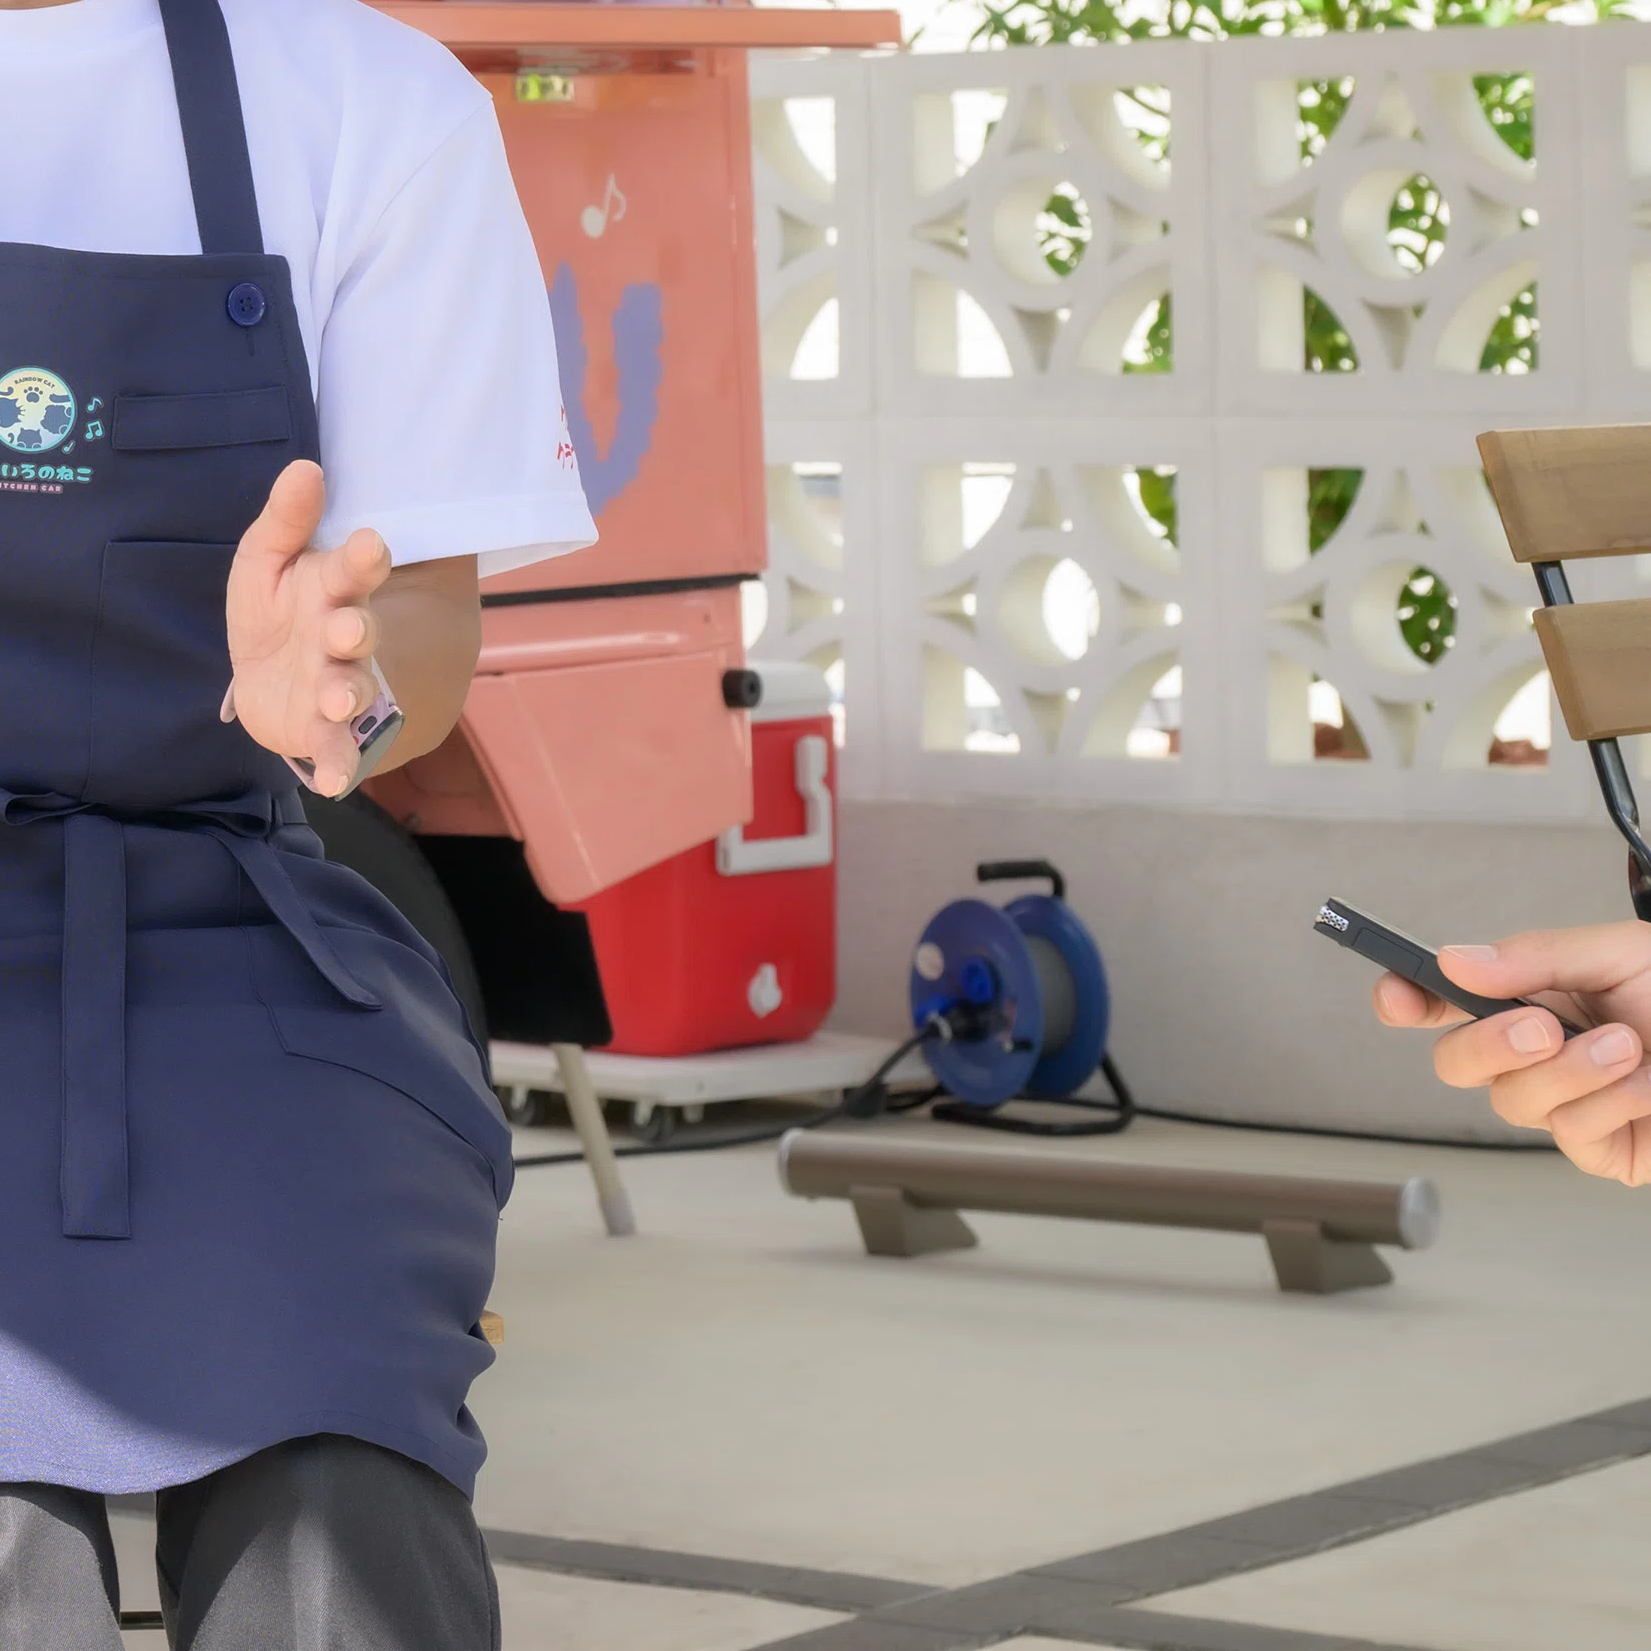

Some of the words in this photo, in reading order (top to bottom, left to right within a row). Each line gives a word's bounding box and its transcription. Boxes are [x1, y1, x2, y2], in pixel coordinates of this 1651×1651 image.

[14, 376, 43, 385] RAINBOW
[43, 378, 56, 389] CAT
[41, 484, 62, 493] CAR
